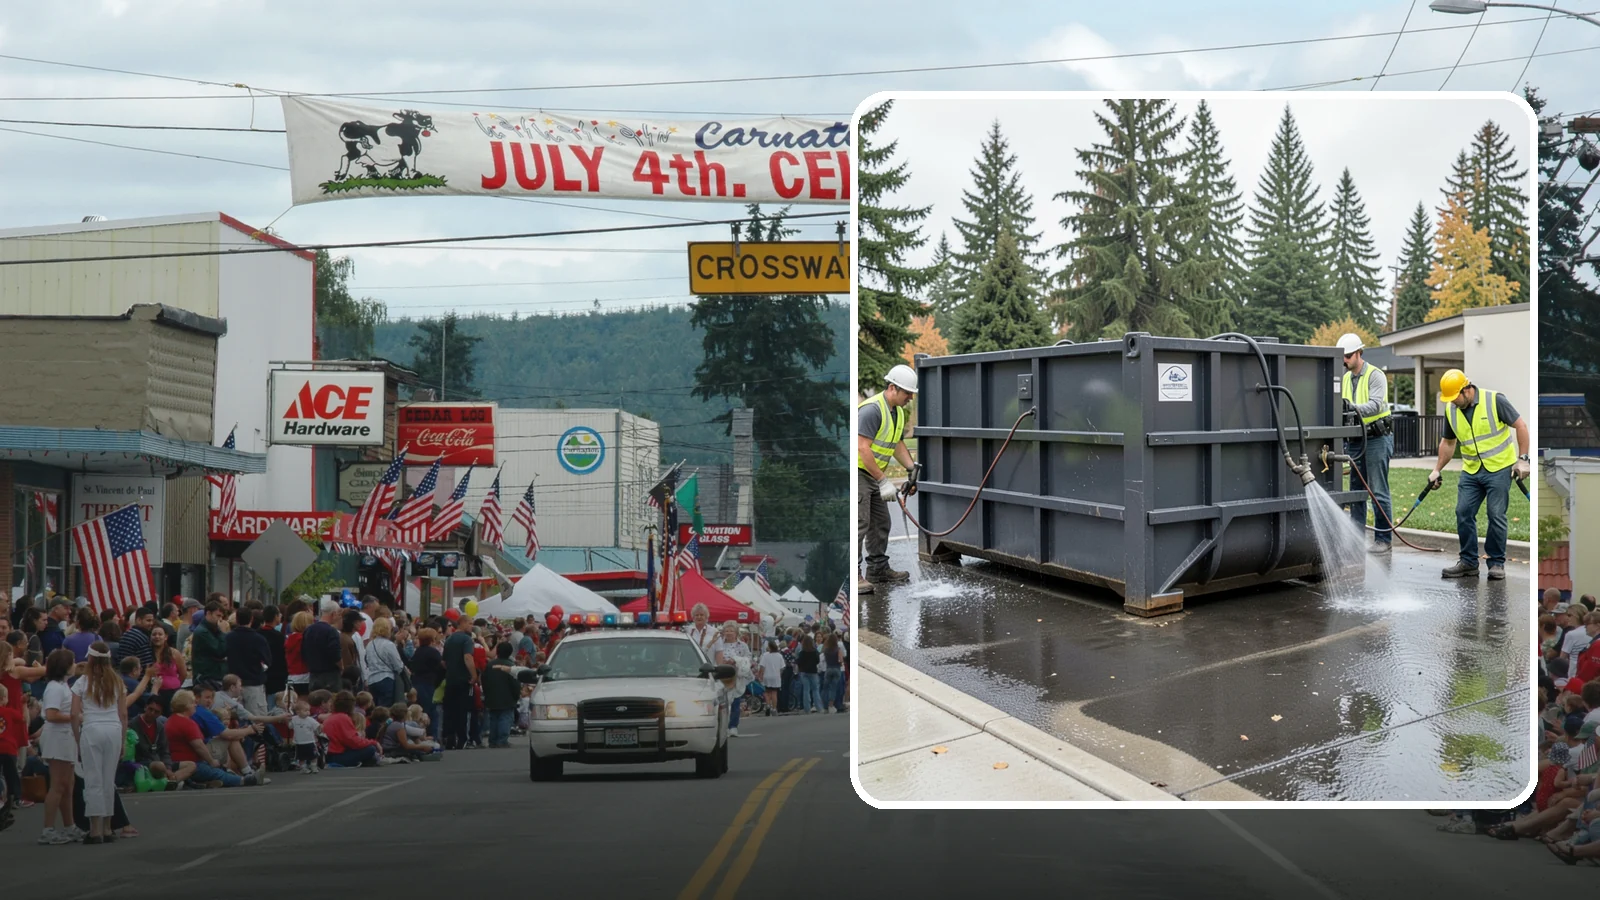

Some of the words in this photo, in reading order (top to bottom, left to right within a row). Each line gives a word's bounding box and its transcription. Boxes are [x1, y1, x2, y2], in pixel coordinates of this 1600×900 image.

[481, 140, 605, 192] JULY
[632, 149, 746, 198] 4th.
[697, 254, 850, 280] CROSSWA
[283, 380, 373, 420] ACE
[406, 409, 452, 422] CEDAR
[461, 409, 485, 422] LOG
[283, 421, 371, 436] Hardware
[416, 428, 477, 447] Coca-Cola
[353, 467, 385, 479] Simpl
[95, 485, 124, 494] Vincent
[126, 486, 135, 494] de
[137, 486, 155, 495] Paul
[81, 503, 154, 522] THRT
[213, 515, 330, 534] HARDARE
[688, 526, 741, 535] CRNATION
[699, 535, 730, 543] GLASS
